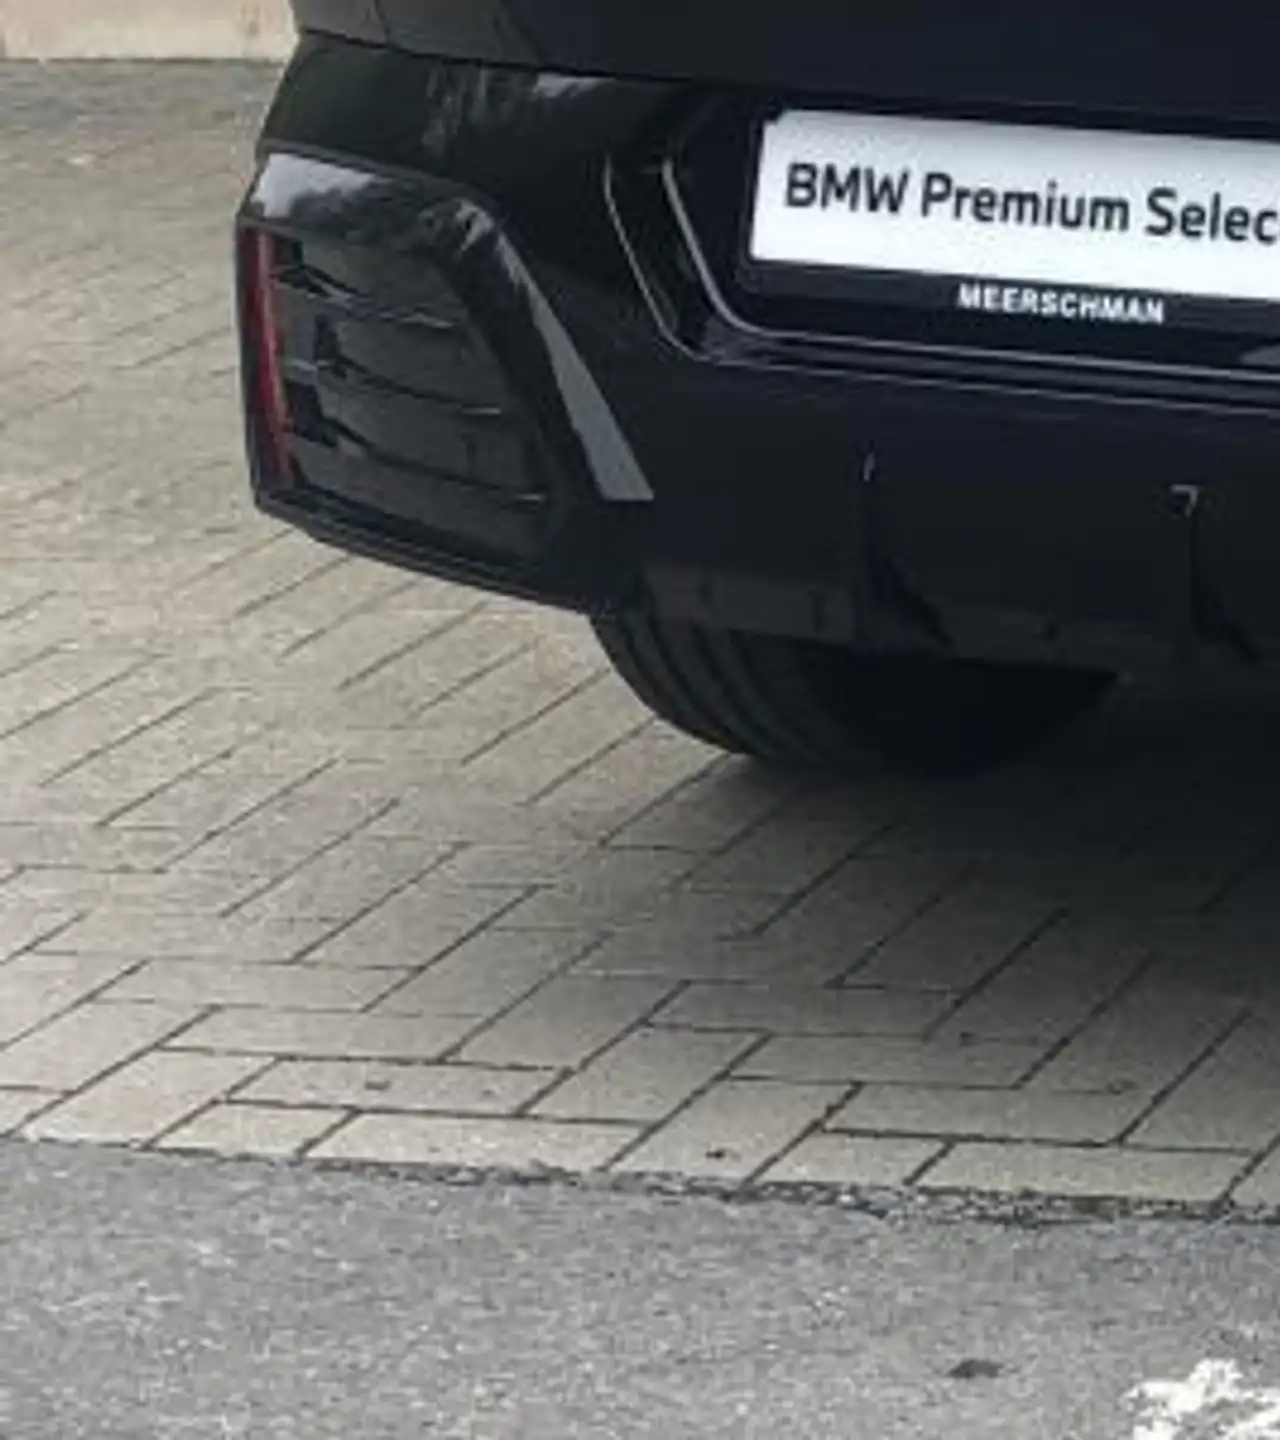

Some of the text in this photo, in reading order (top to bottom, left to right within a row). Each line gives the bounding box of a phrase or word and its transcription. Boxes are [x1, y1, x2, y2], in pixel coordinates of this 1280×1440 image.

[785, 161, 910, 214] BMW
[919, 171, 1130, 232] Premium
[957, 281, 1164, 325] MEERSCHMAN
